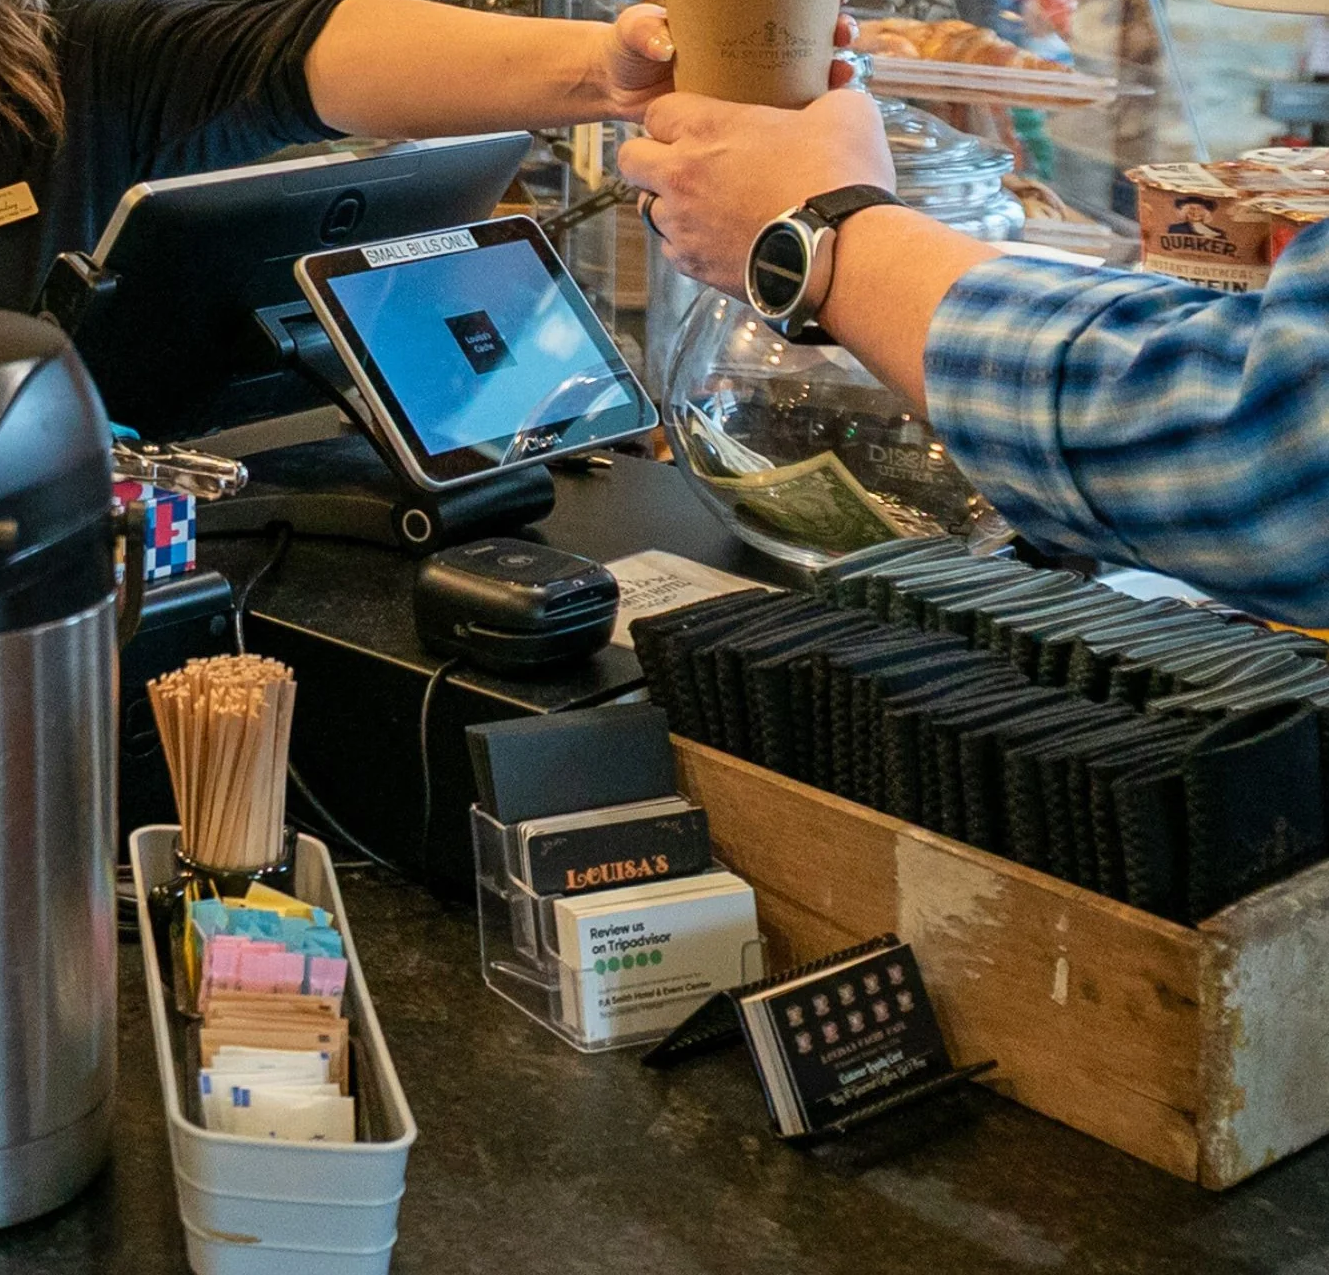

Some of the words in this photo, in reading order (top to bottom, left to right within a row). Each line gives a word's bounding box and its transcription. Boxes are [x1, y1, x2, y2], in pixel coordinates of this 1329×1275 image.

[366, 245, 408, 263] SMALL
[406, 239, 442, 256] BILLS
[442, 233, 473, 250] ONLY
[1161, 235, 1237, 257] QUAKER
[1192, 266, 1253, 280] OATMEAL
[565, 854, 670, 889] LOUISA'S
[590, 926, 630, 940] Review
[632, 922, 645, 933] us
[592, 944, 606, 955] on
[608, 933, 671, 953] Tripadvisor
